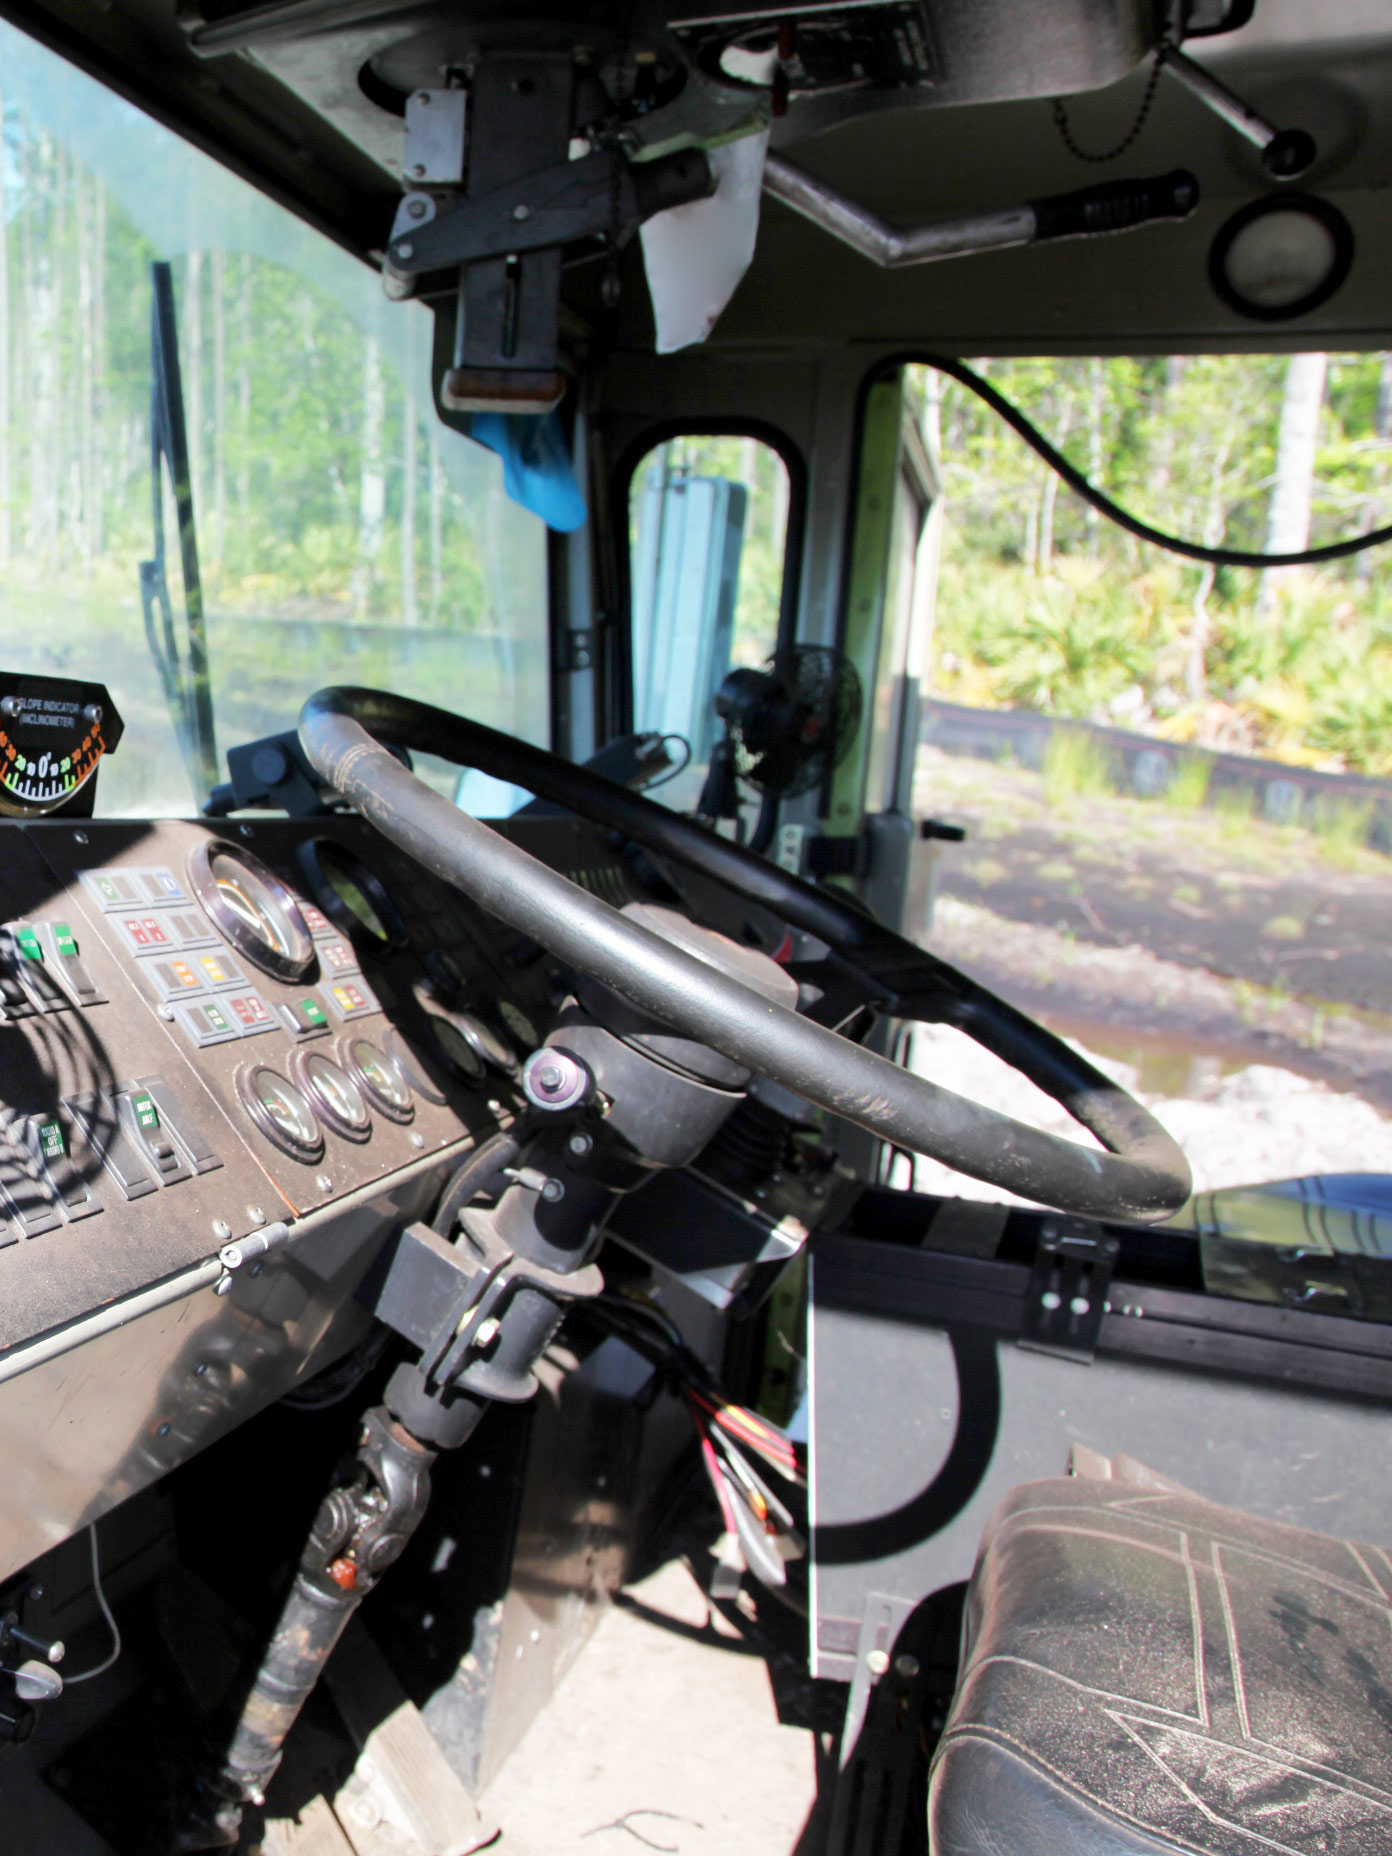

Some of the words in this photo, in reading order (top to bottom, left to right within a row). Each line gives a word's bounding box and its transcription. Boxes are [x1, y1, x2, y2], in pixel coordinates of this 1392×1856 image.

[18, 698, 42, 711] SLOPE
[43, 701, 80, 714] INDICATOR
[20, 713, 75, 728] INCLINOMETER
[48, 1135, 57, 1146] OFF
